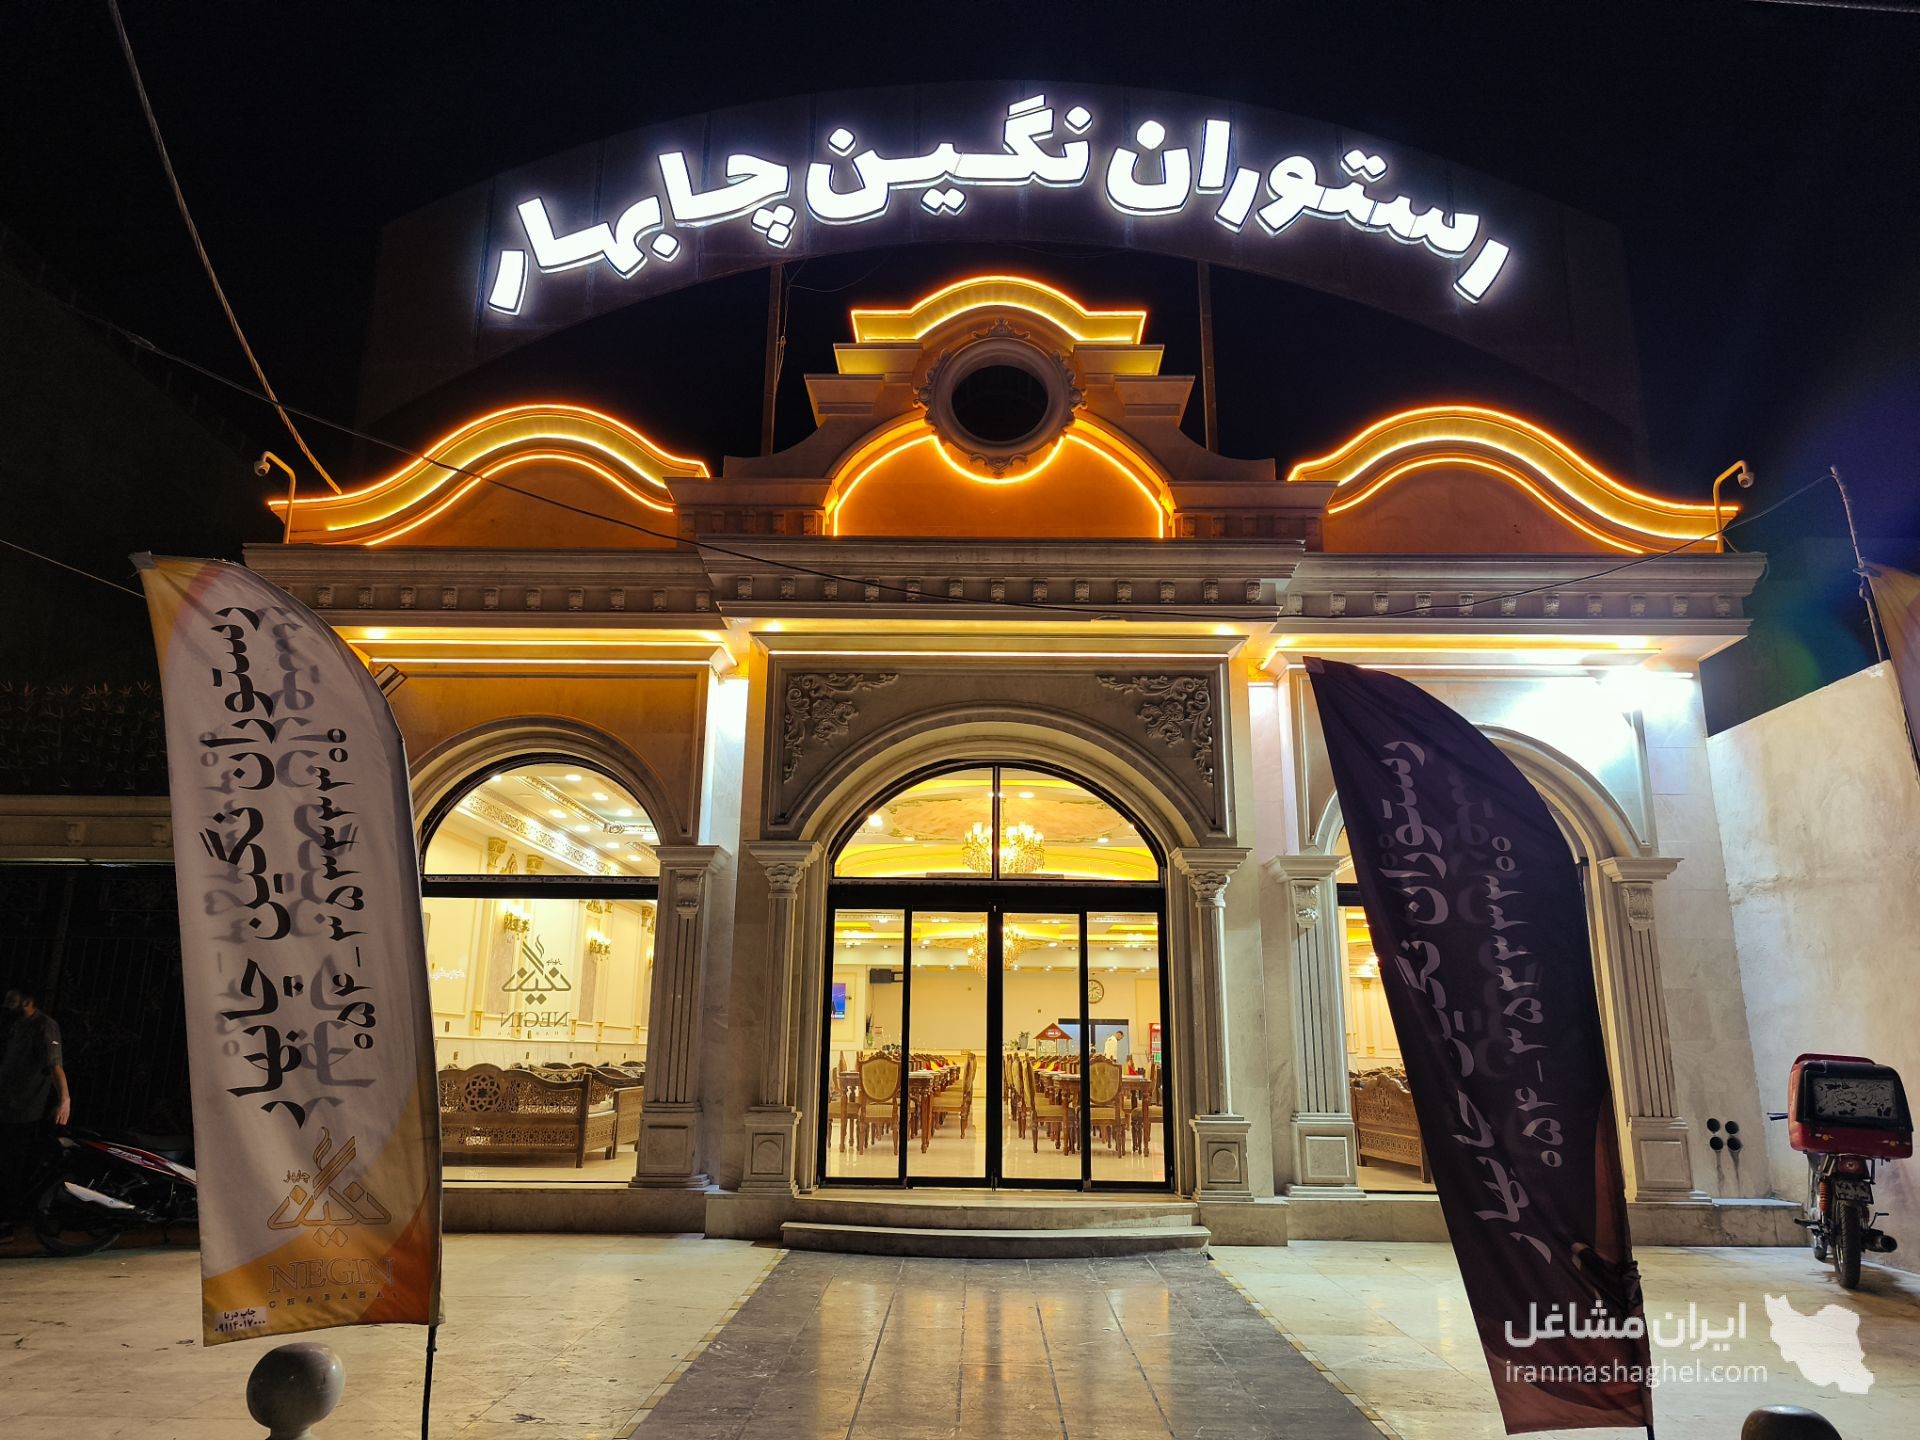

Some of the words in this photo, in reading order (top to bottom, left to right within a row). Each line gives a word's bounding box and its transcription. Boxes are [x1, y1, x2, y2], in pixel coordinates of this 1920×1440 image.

[485, 150, 796, 316] چابهار
[804, 93, 1093, 225] نگین
[1105, 118, 1512, 304] رستوران
[200, 607, 276, 790] رستوران
[200, 806, 292, 941] نگین
[1378, 741, 1449, 925] رستوران
[221, 958, 304, 1130] چابهار
[267, 1256, 397, 1294] NEGIN
